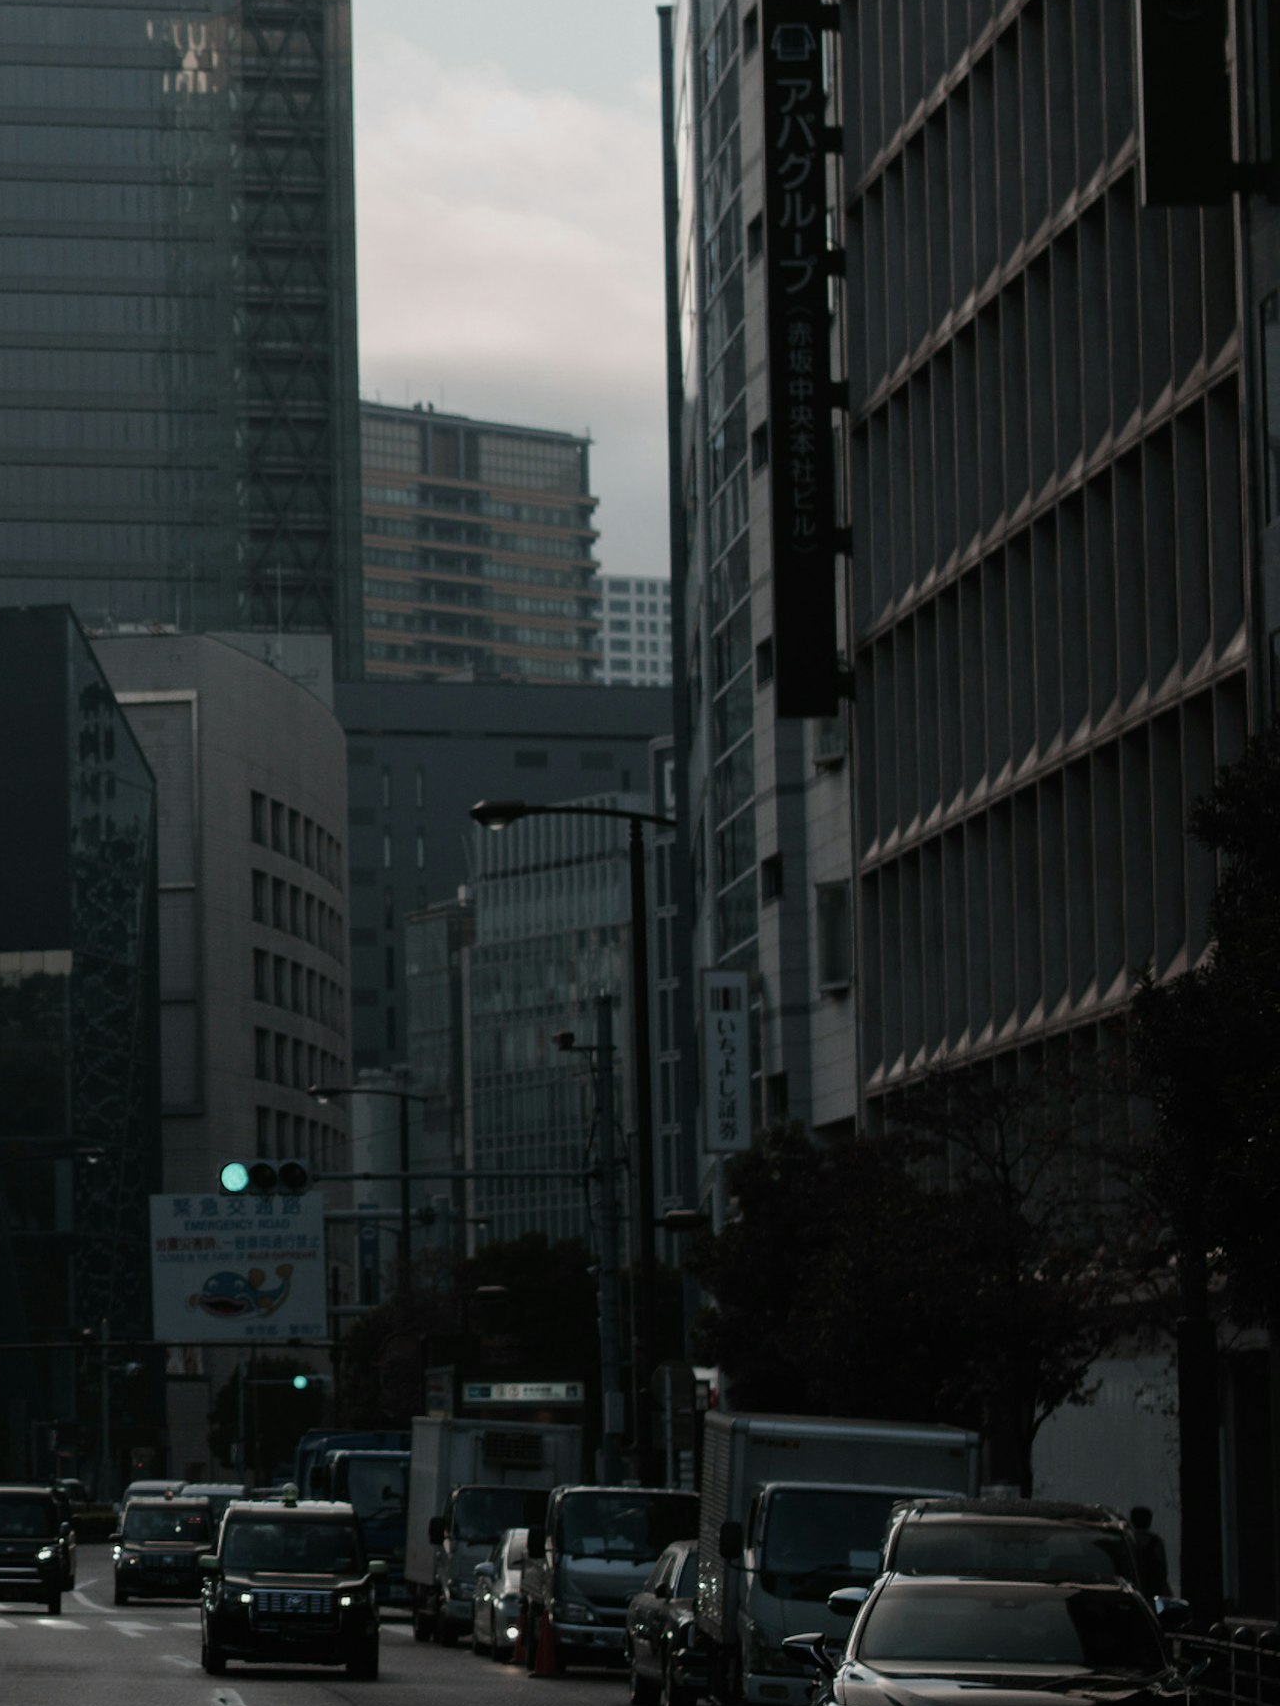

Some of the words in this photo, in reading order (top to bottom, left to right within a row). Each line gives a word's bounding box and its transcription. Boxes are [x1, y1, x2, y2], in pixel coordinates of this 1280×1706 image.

[716, 1017, 739, 1142] いちよし証券
[184, 1220, 254, 1231] EMERGENCY
[258, 1219, 290, 1230] ROAD
